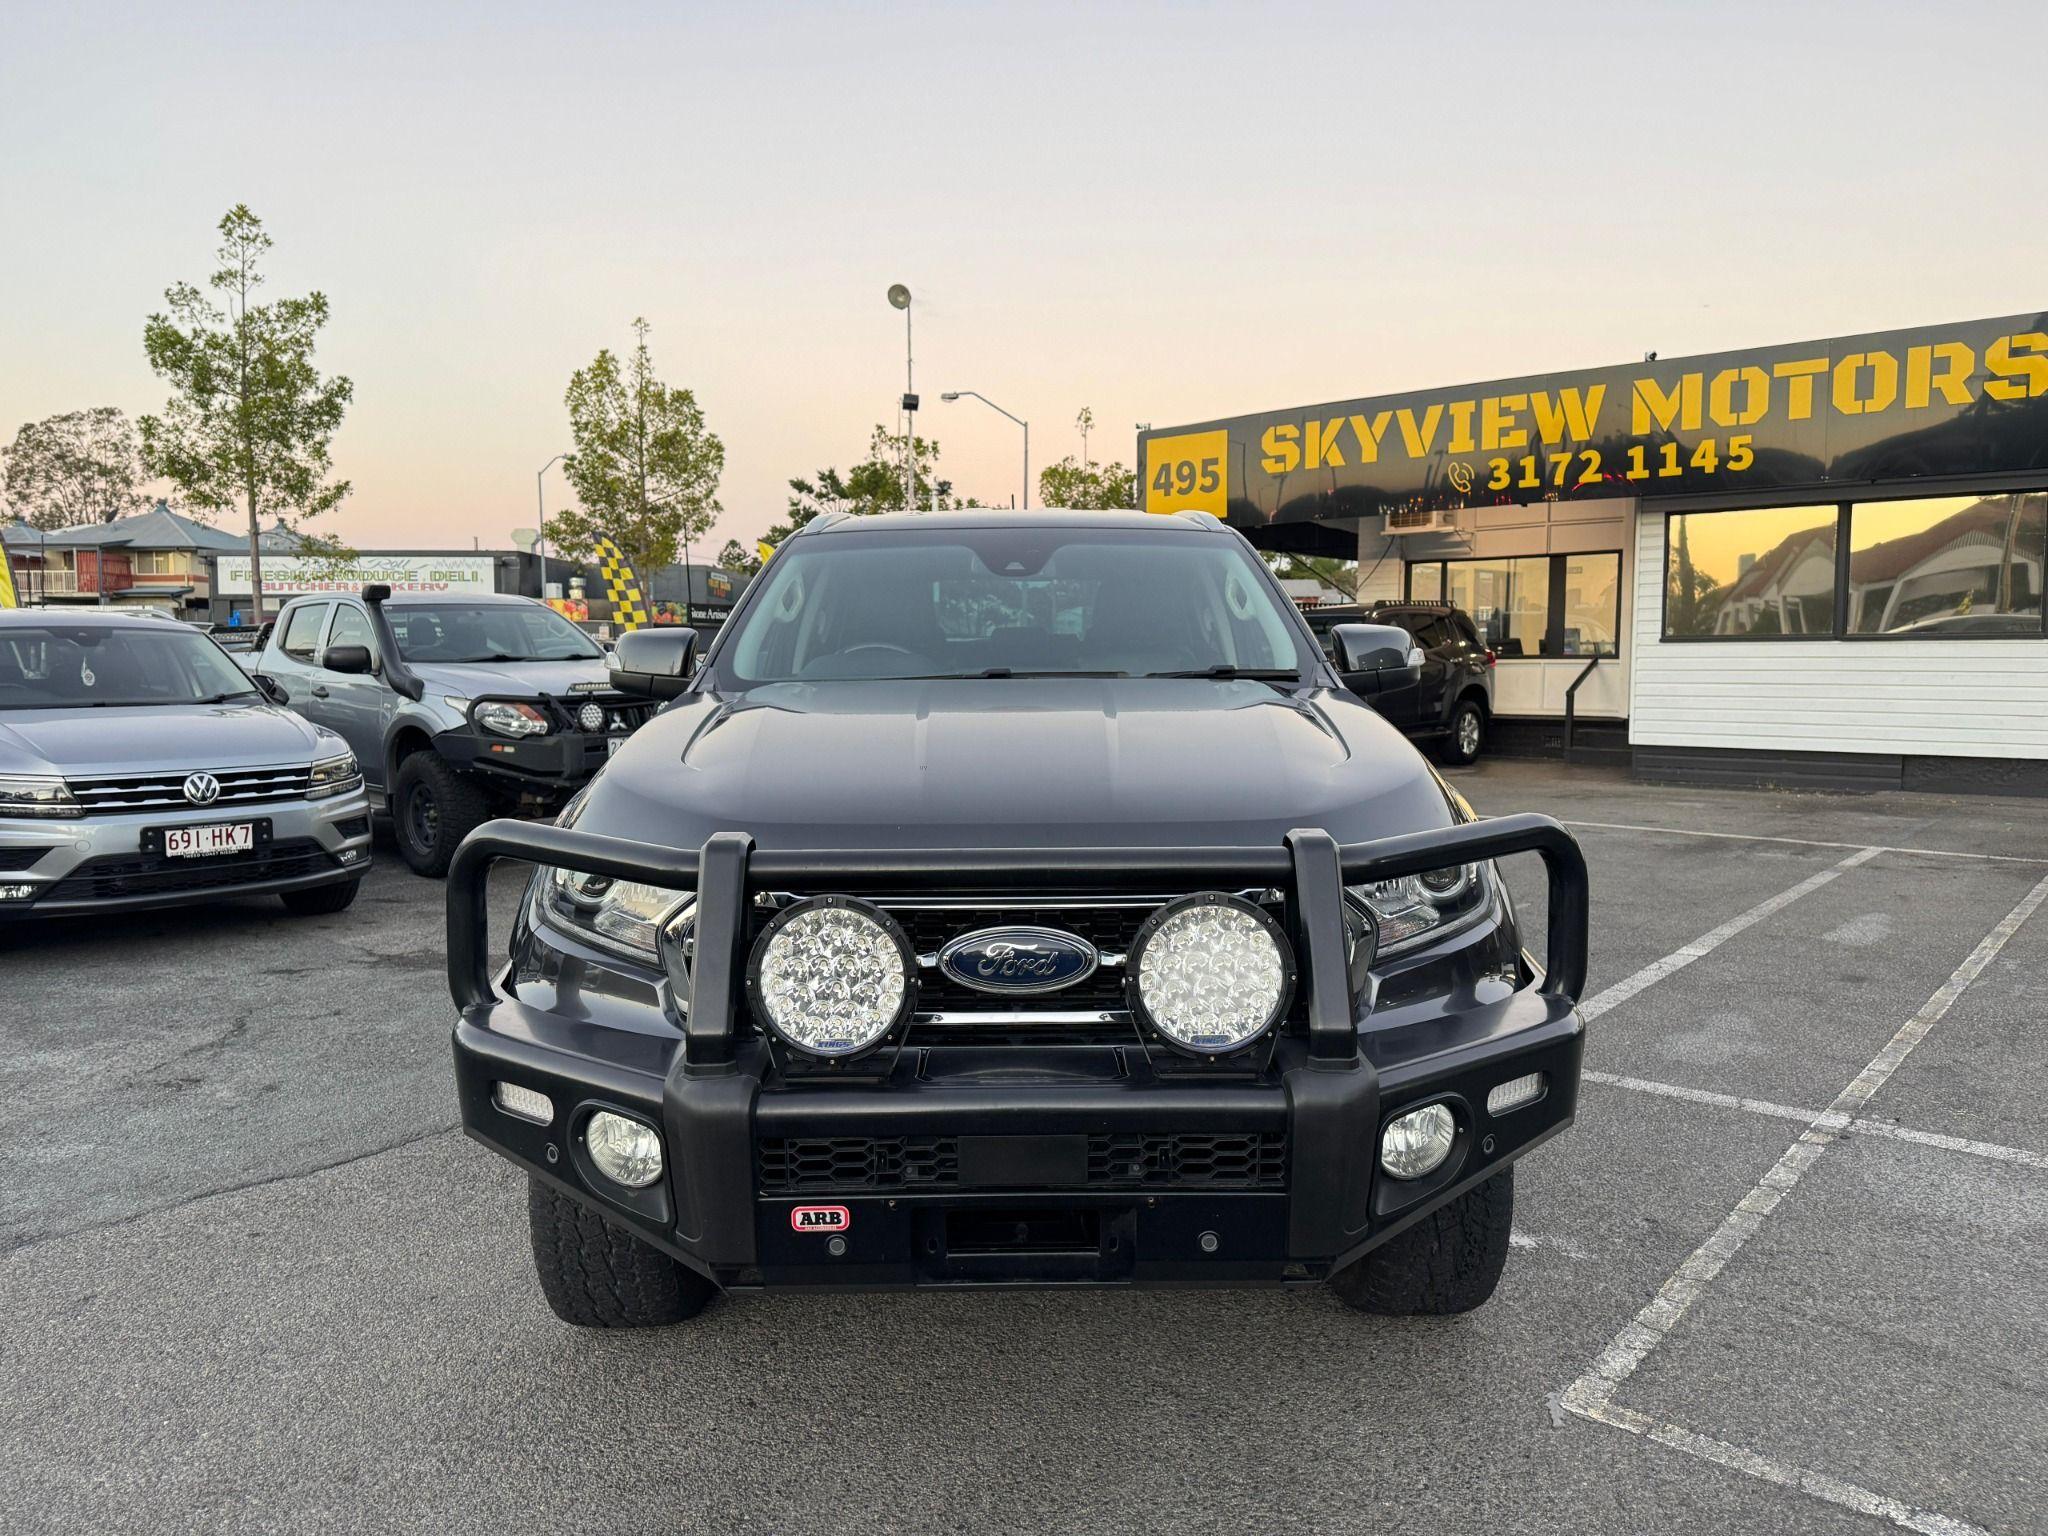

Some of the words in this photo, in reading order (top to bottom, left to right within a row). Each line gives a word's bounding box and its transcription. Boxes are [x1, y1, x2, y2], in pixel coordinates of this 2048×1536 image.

[1261, 384, 1606, 474] SKYVIEW
[1631, 331, 2048, 436] MOTORS
[1152, 457, 1220, 497] 495
[1488, 449, 1603, 491] 3172
[1626, 435, 1754, 480] 1145
[977, 942, 1059, 976] Ford
[799, 1211, 843, 1226] ARB
